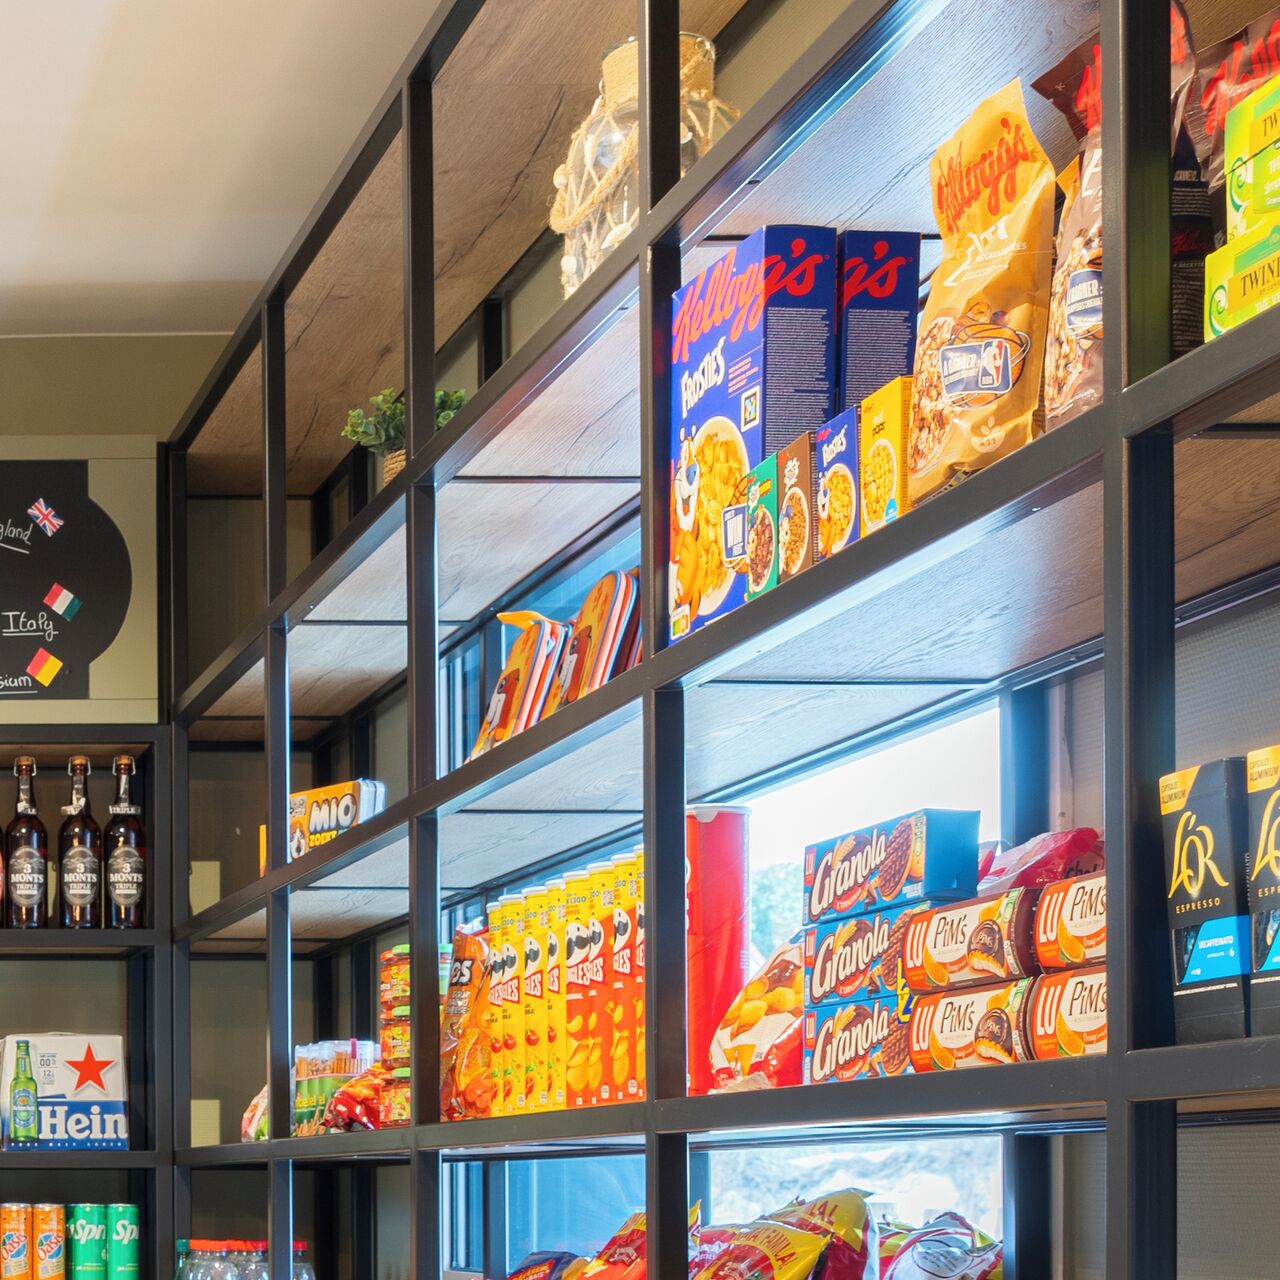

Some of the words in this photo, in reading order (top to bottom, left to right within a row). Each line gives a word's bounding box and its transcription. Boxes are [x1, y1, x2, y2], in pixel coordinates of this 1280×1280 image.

[1, 611, 58, 641] Italy
[309, 794, 356, 833] MIO
[11, 874, 43, 883] MONTS
[24, 863, 31, 872] 3
[64, 874, 96, 883] MONTS
[76, 863, 84, 872] 3
[110, 874, 142, 883] MONTS
[122, 863, 130, 872] 3
[811, 828, 887, 916] Granola
[1040, 892, 1064, 943] LU
[1176, 898, 1220, 913] ESPRESSO
[812, 915, 889, 999] Granola
[907, 921, 927, 968] LU
[1037, 985, 1061, 1036] LU
[812, 1000, 889, 1081] Granola
[913, 1005, 934, 1051] LU
[2, 1232, 27, 1261] Oasis
[39, 1232, 63, 1261] Oasis
